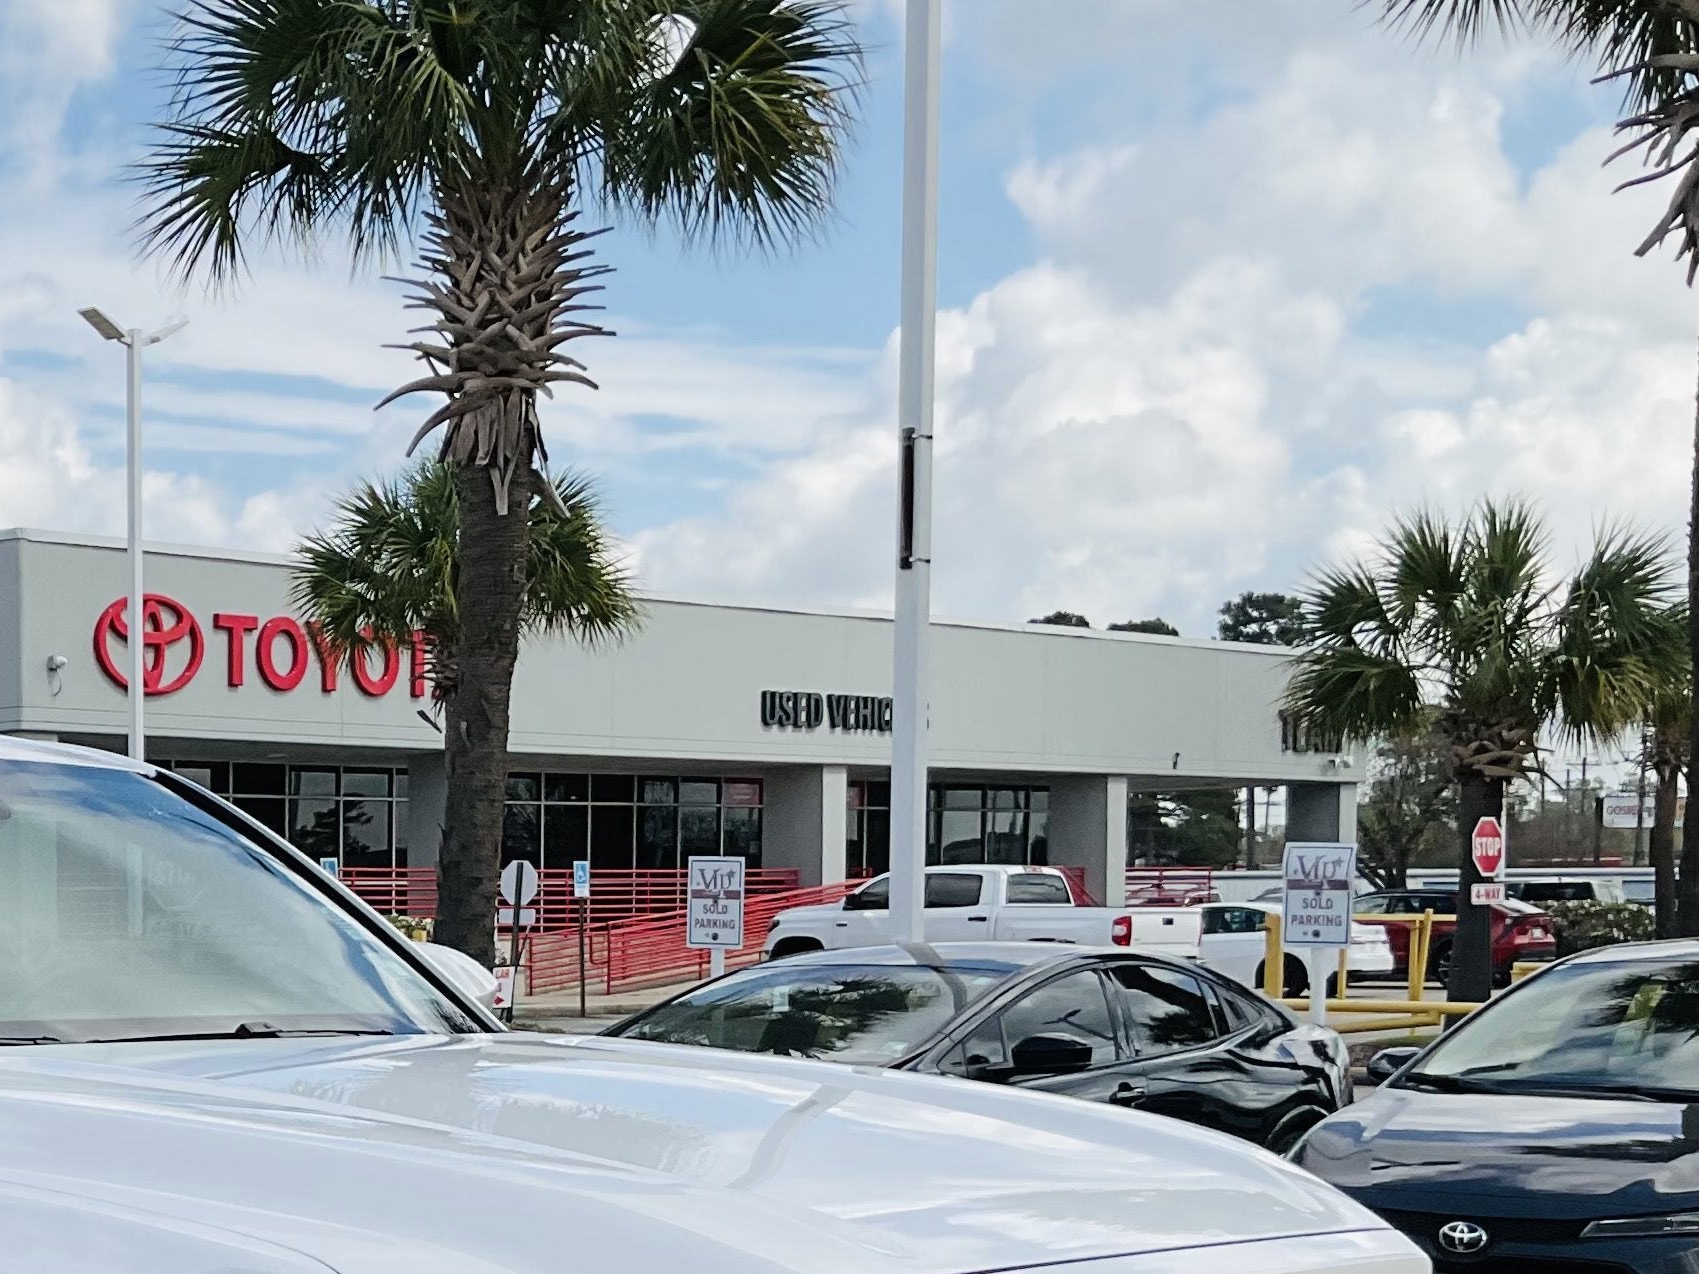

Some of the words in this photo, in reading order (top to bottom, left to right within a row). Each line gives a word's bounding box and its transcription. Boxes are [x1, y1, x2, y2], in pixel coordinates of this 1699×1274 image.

[213, 613, 443, 700] TOYOT
[761, 691, 824, 729] USED
[826, 694, 930, 732] VEHIC
[1475, 837, 1501, 857] STOP
[1475, 888, 1501, 900] 4-WAY
[702, 904, 728, 915] SOLD
[1302, 898, 1333, 909] SOLD
[694, 918, 736, 930] PARKING
[1291, 914, 1343, 927] PARKING
